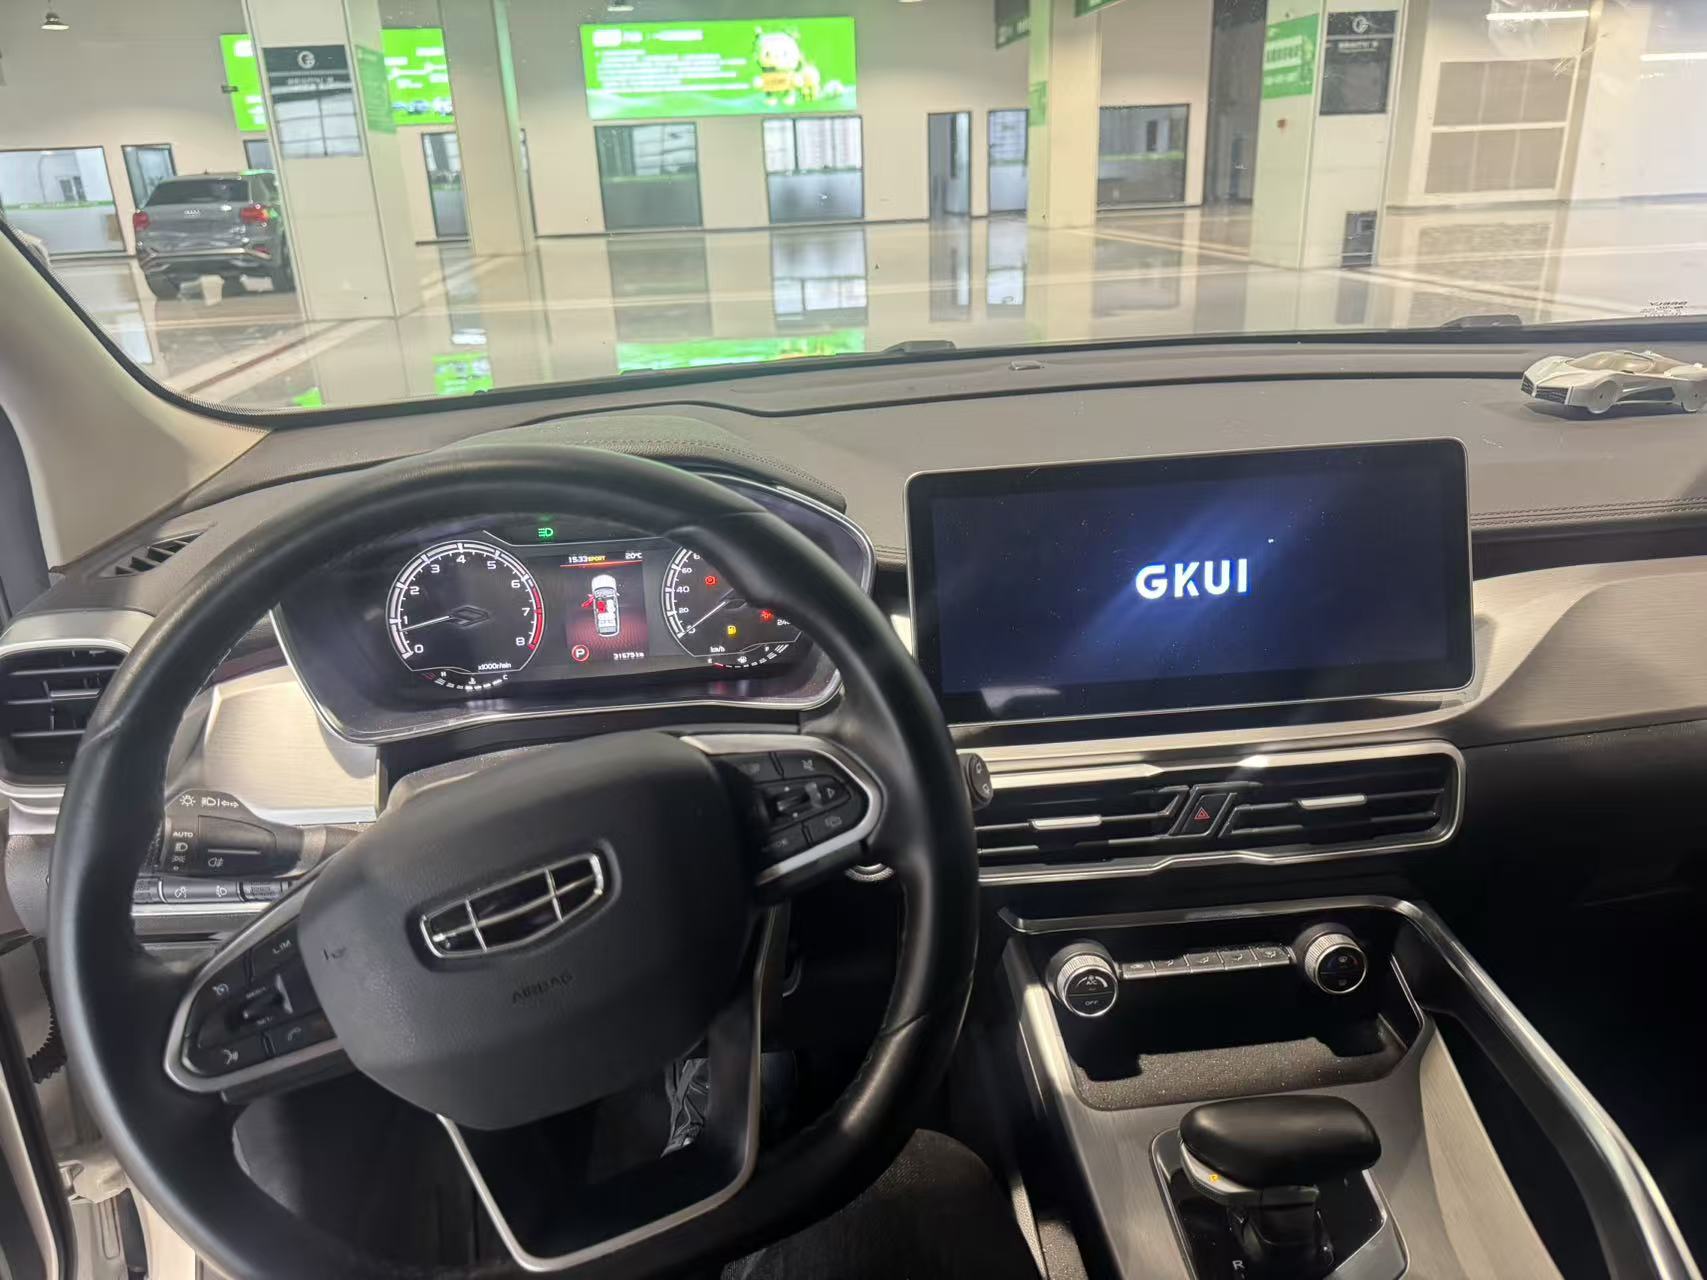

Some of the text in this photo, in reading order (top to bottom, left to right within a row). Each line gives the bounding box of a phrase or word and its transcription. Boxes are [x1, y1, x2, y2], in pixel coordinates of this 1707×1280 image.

[456, 555, 466, 564] 4
[430, 564, 440, 573] 3
[487, 560, 497, 570] 5
[1135, 558, 1248, 599] GKUI
[511, 579, 521, 588] 6
[410, 586, 420, 595] 2
[676, 585, 690, 593] 40
[521, 607, 531, 616] 7
[403, 615, 409, 624] 1
[515, 636, 526, 646] 8
[414, 644, 424, 653] 0
[710, 645, 726, 653] km/h
[173, 831, 194, 839] AUTO
[1232, 1259, 1246, 1270] R
